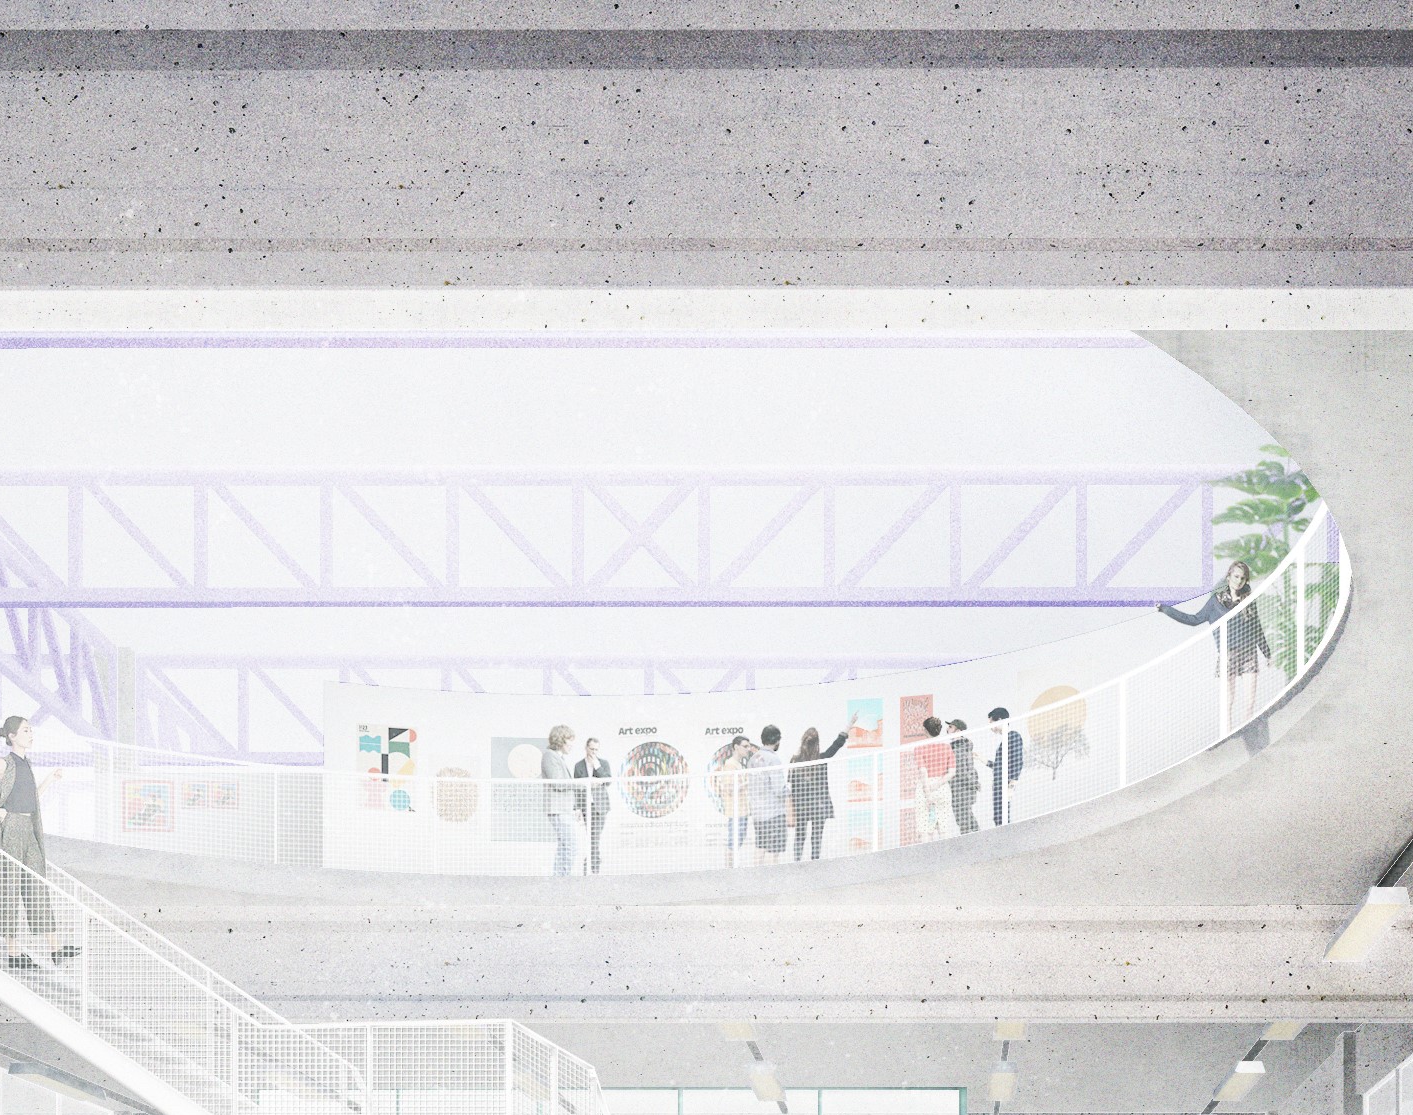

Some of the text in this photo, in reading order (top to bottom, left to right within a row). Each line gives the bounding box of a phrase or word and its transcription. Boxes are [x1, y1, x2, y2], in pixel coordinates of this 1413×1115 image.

[618, 727, 657, 735] Art expo
[705, 727, 743, 735] Art expo
